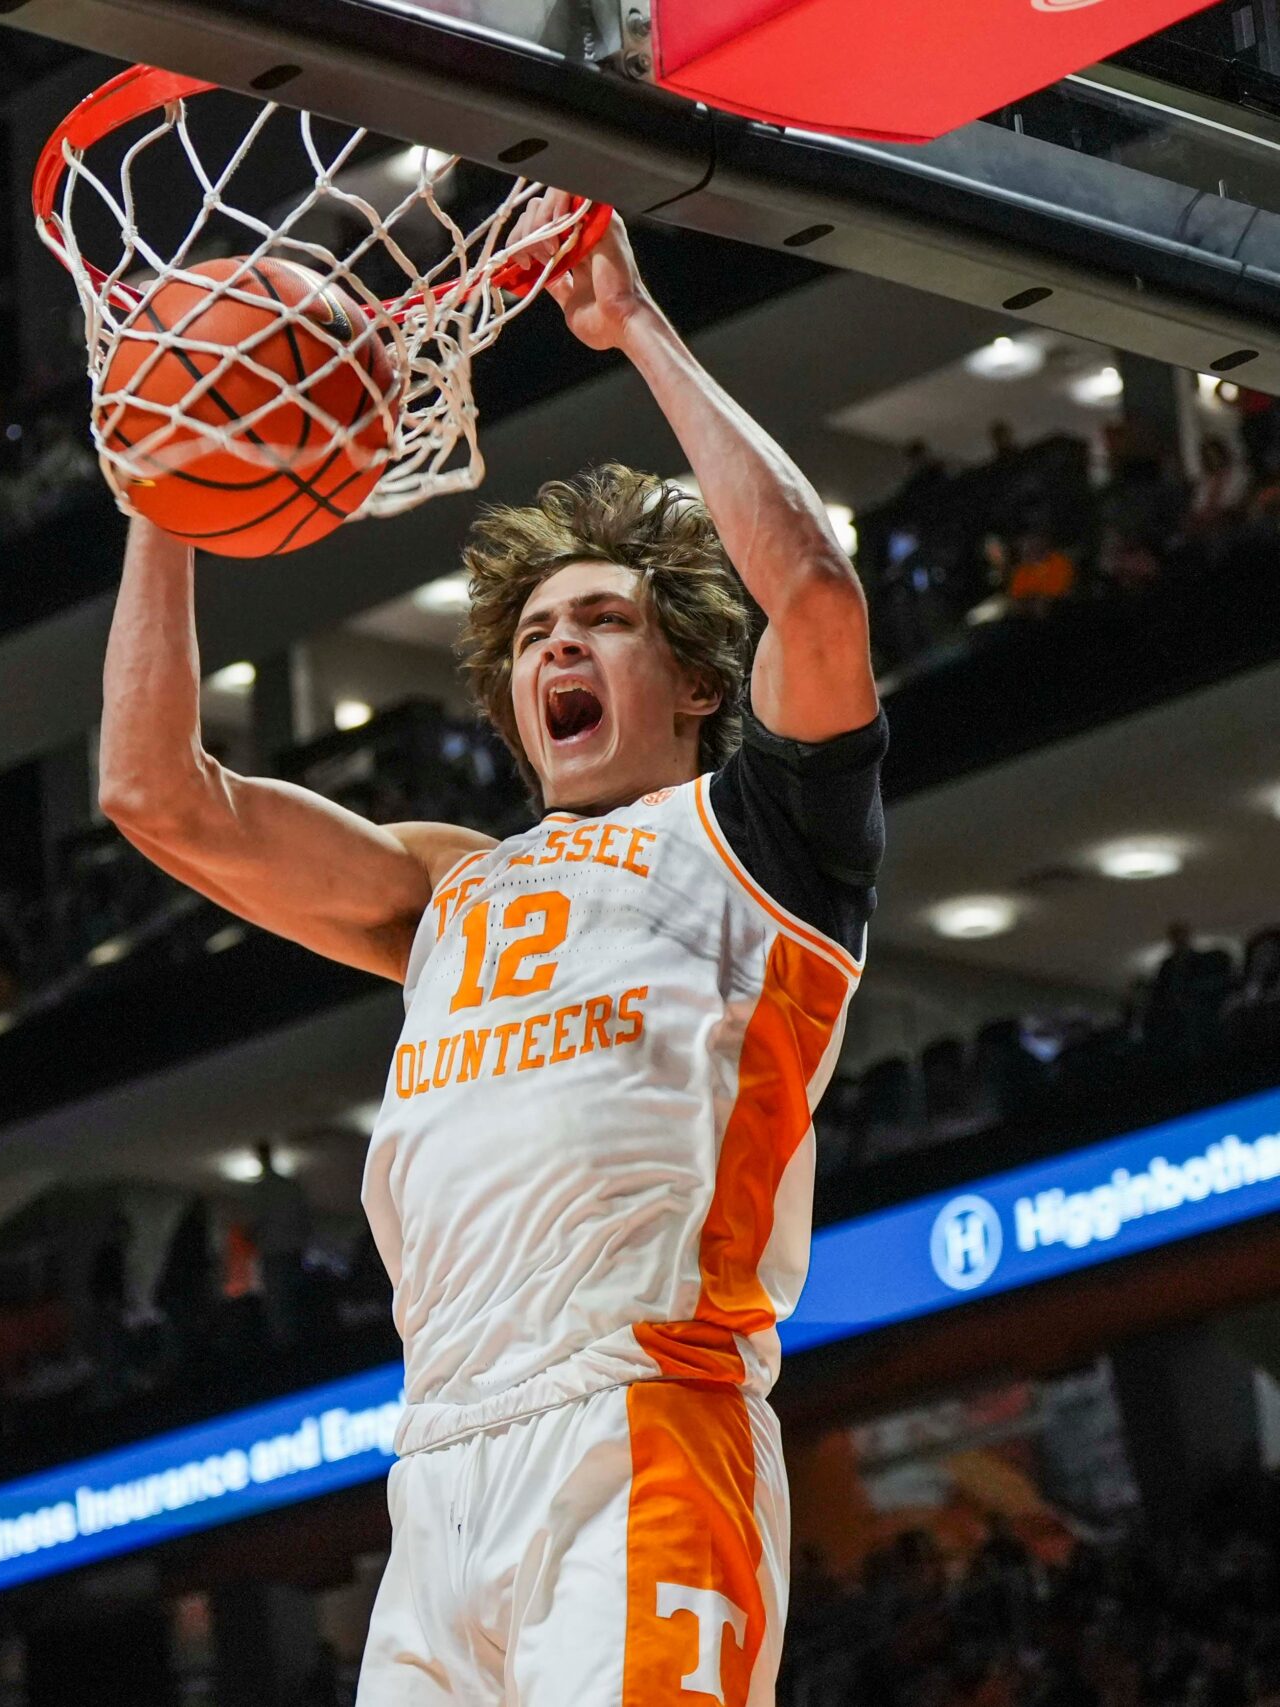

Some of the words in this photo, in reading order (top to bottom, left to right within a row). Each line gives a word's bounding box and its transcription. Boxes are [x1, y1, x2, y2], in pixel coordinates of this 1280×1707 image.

[433, 824, 656, 944] TESSEE
[449, 890, 571, 1016] 12
[396, 985, 649, 1098] OLUNTEERS
[1014, 1129, 1280, 1251] Higginbotha
[75, 1448, 250, 1536] Insurance
[249, 1416, 322, 1483] and
[321, 1388, 405, 1463] Emp
